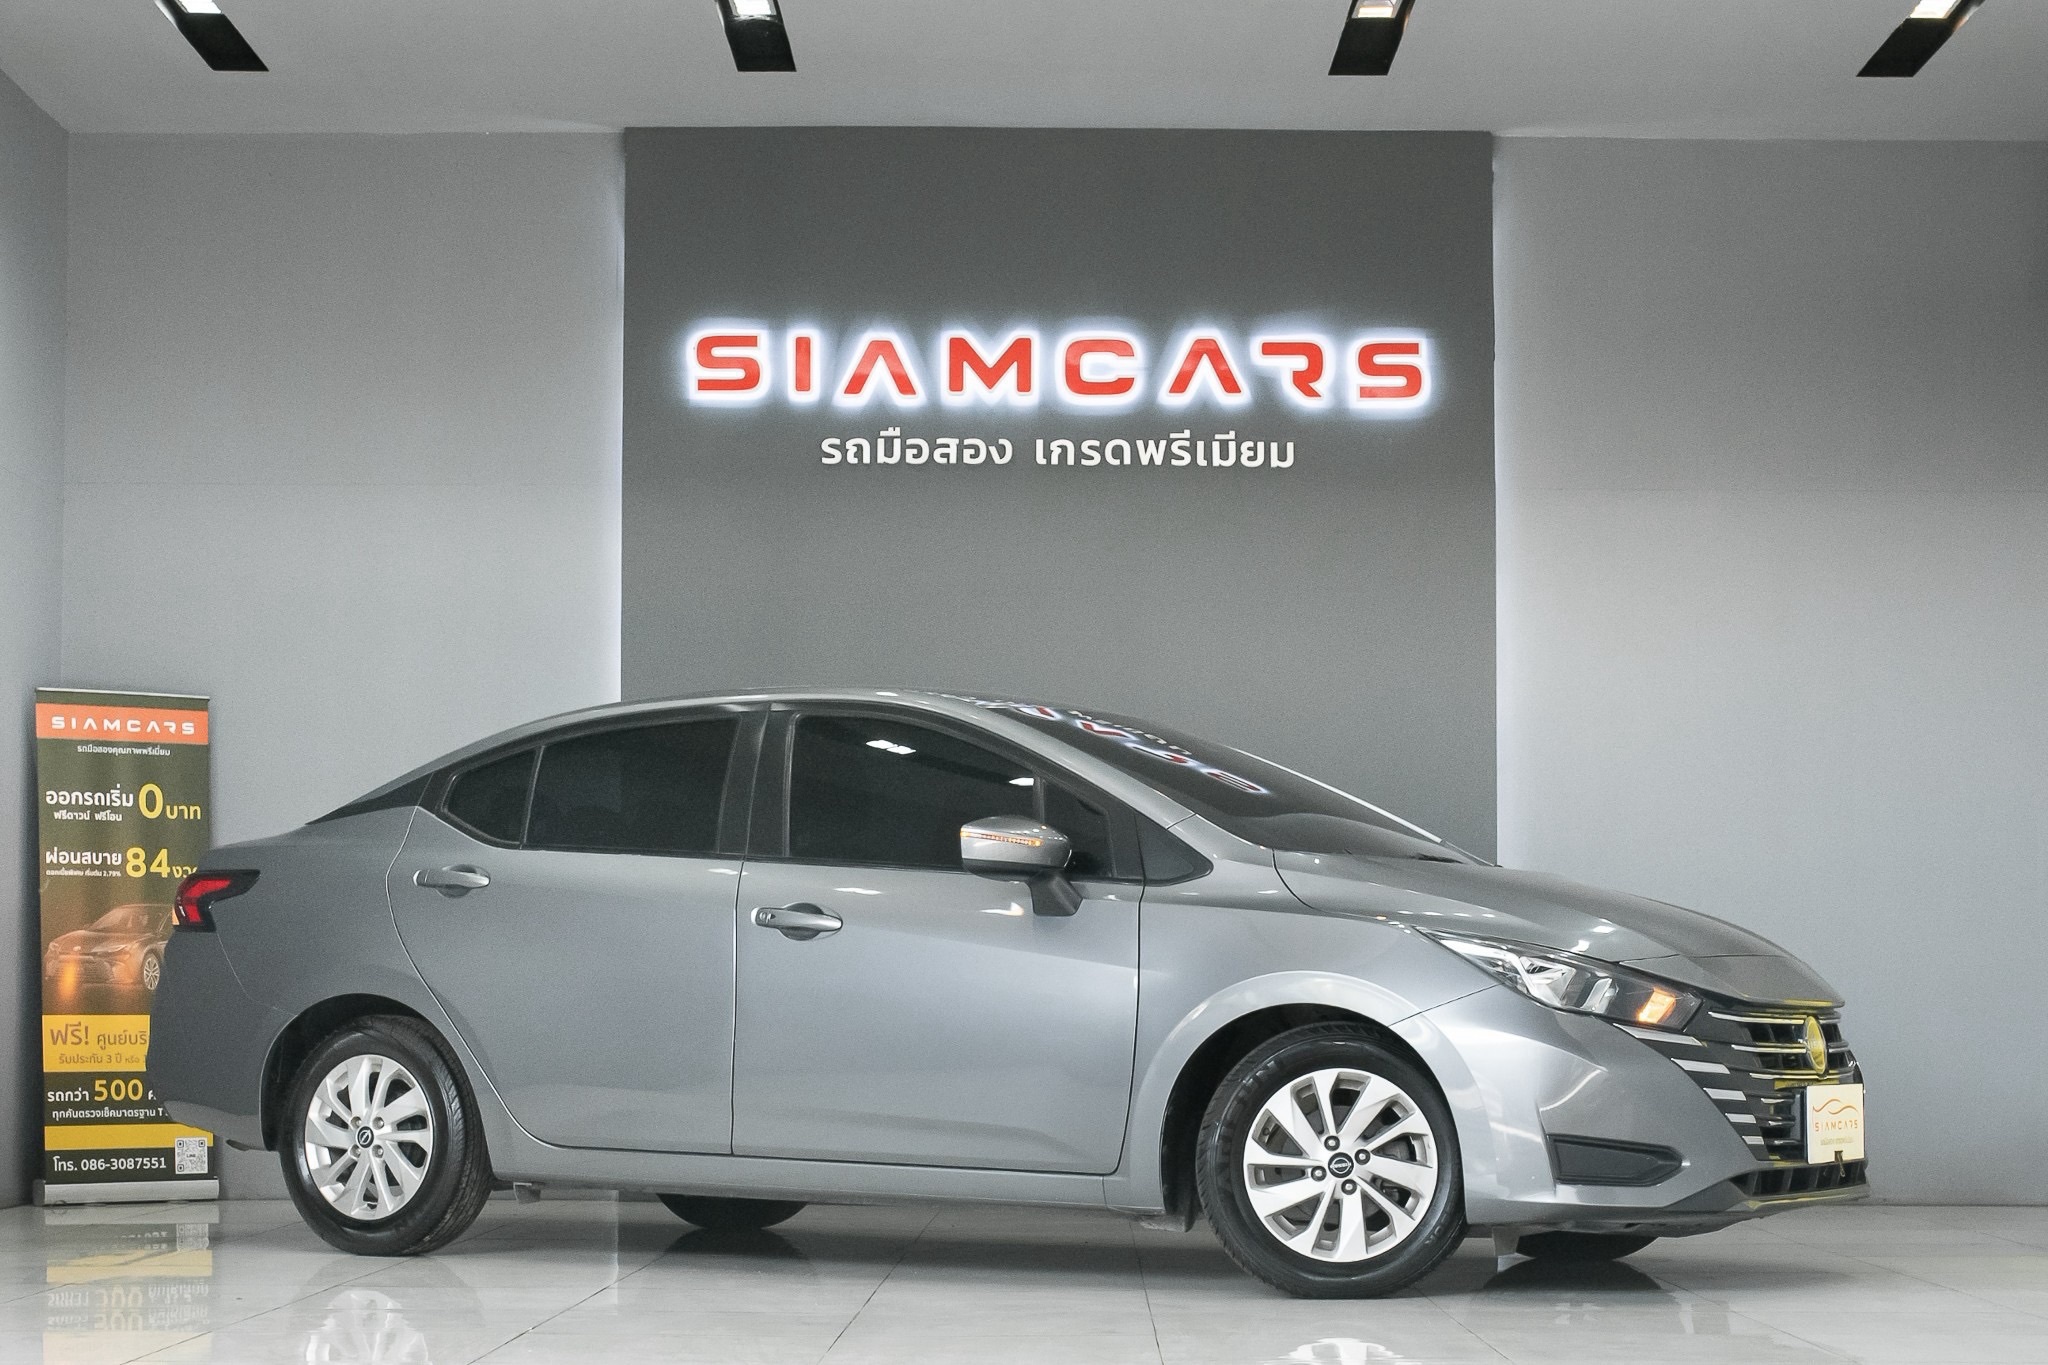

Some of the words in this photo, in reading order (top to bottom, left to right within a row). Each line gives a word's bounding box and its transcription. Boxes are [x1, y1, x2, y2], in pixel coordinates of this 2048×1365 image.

[694, 334, 1424, 400] SIAMCARS
[820, 426, 1013, 466] รถมือสอง
[1034, 428, 1295, 469] เกรดพรีเมียม
[51, 716, 195, 735] SIAMCARS
[45, 783, 134, 807] ออกรถเริ่ม
[138, 783, 164, 819] 0
[165, 804, 202, 820] บาท
[53, 810, 91, 821] ฟรีดาวน์
[94, 810, 123, 822] ฟรีโอน
[45, 846, 122, 866] ผ่อนสบาย
[126, 847, 171, 879] 84
[50, 1021, 89, 1046] ฟรี!
[96, 1029, 147, 1051] ศูนย์บริ
[59, 1053, 103, 1065] รับประกัน
[106, 1054, 112, 1064] 3
[114, 1052, 122, 1064] ปี
[47, 1087, 89, 1102] รถกว่า
[94, 1078, 143, 1101] 500
[53, 1156, 78, 1172] โทร.
[80, 1157, 167, 1171] 086-3087551
